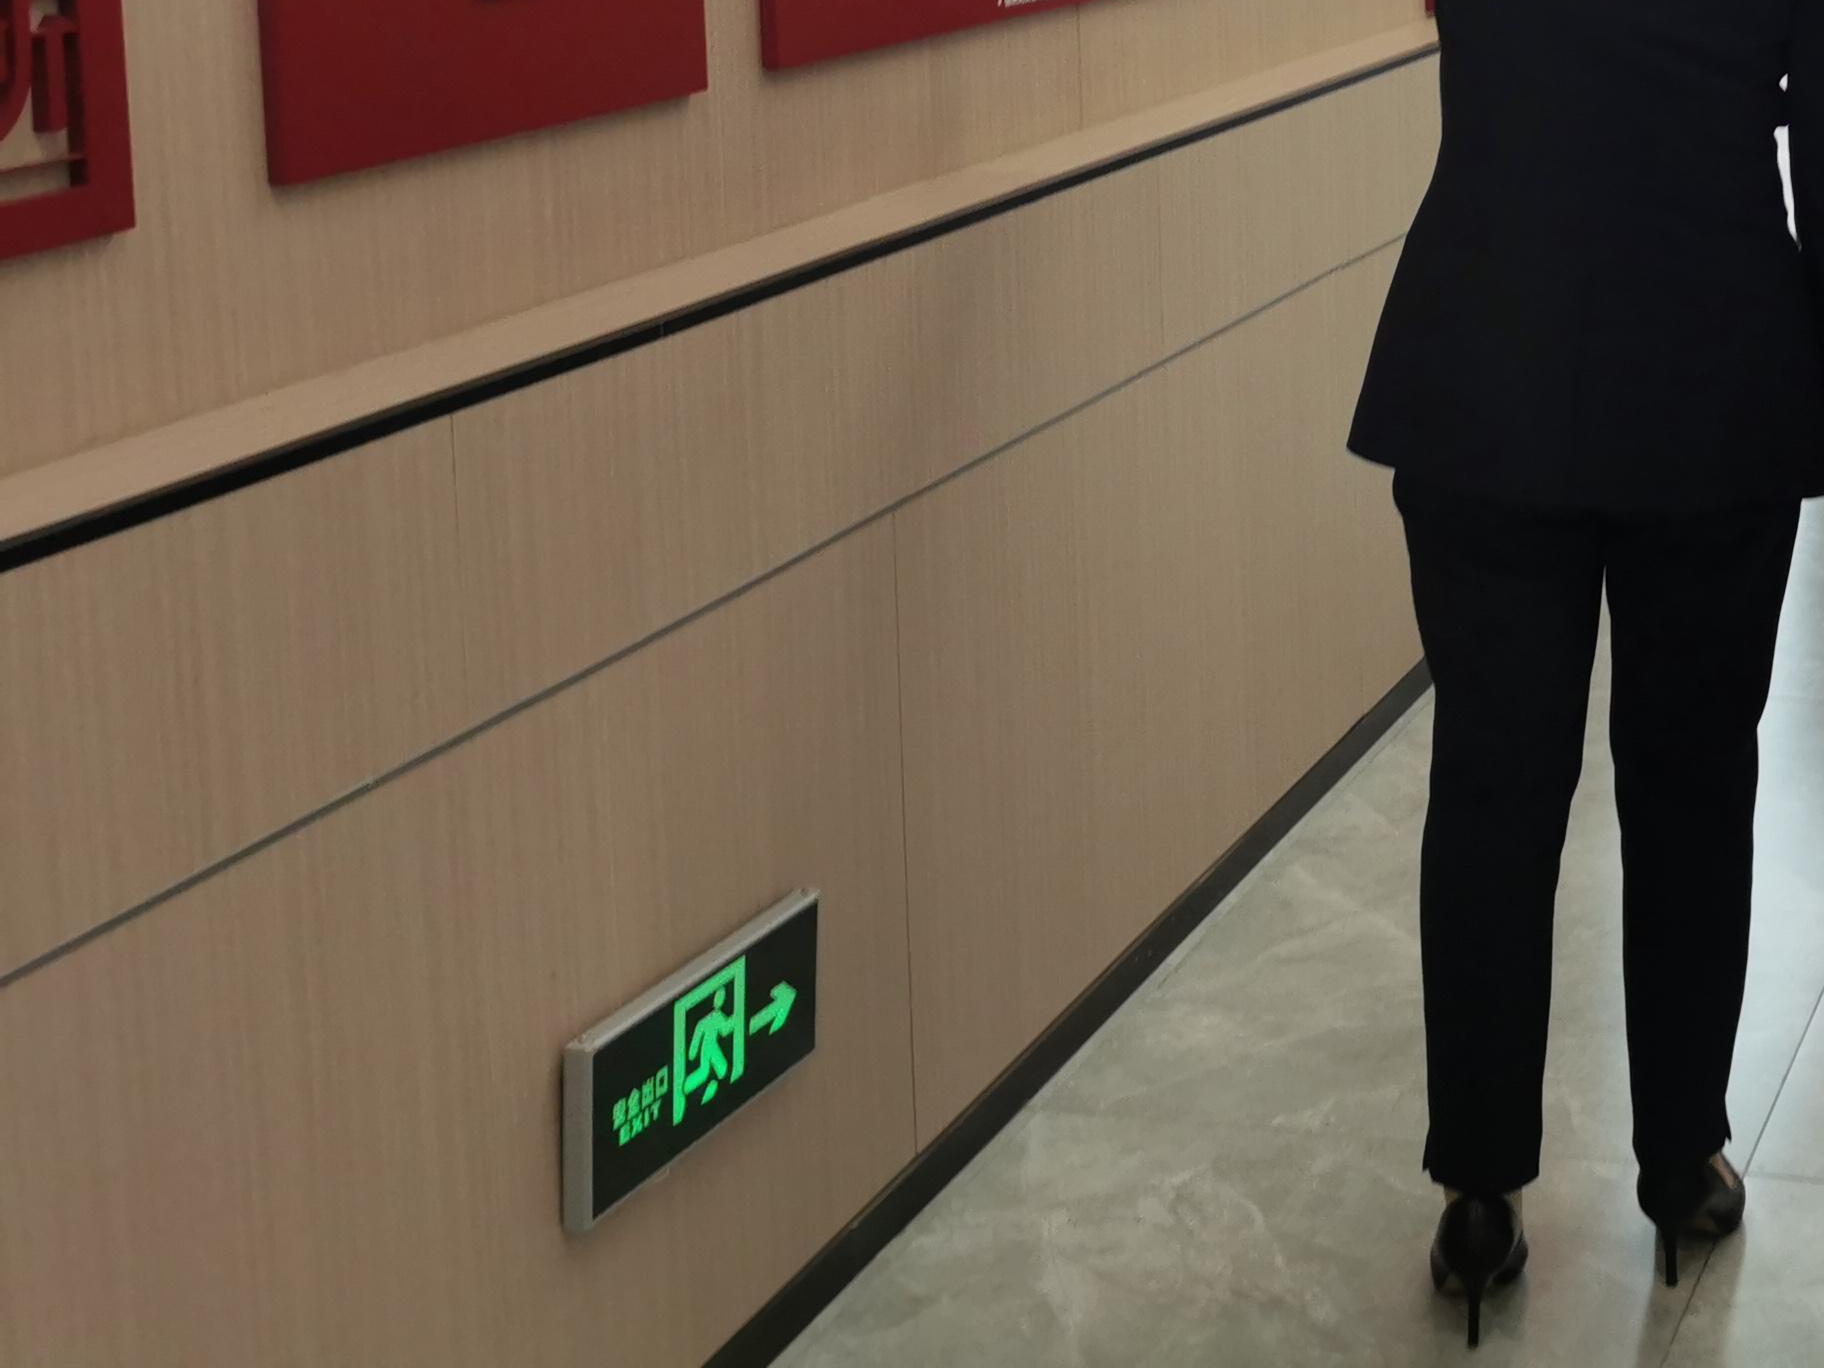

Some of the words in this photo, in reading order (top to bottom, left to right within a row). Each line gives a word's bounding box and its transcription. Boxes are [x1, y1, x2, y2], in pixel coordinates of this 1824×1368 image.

[612, 1064, 669, 1131] 安全出口
[619, 1098, 662, 1147] EXIT
